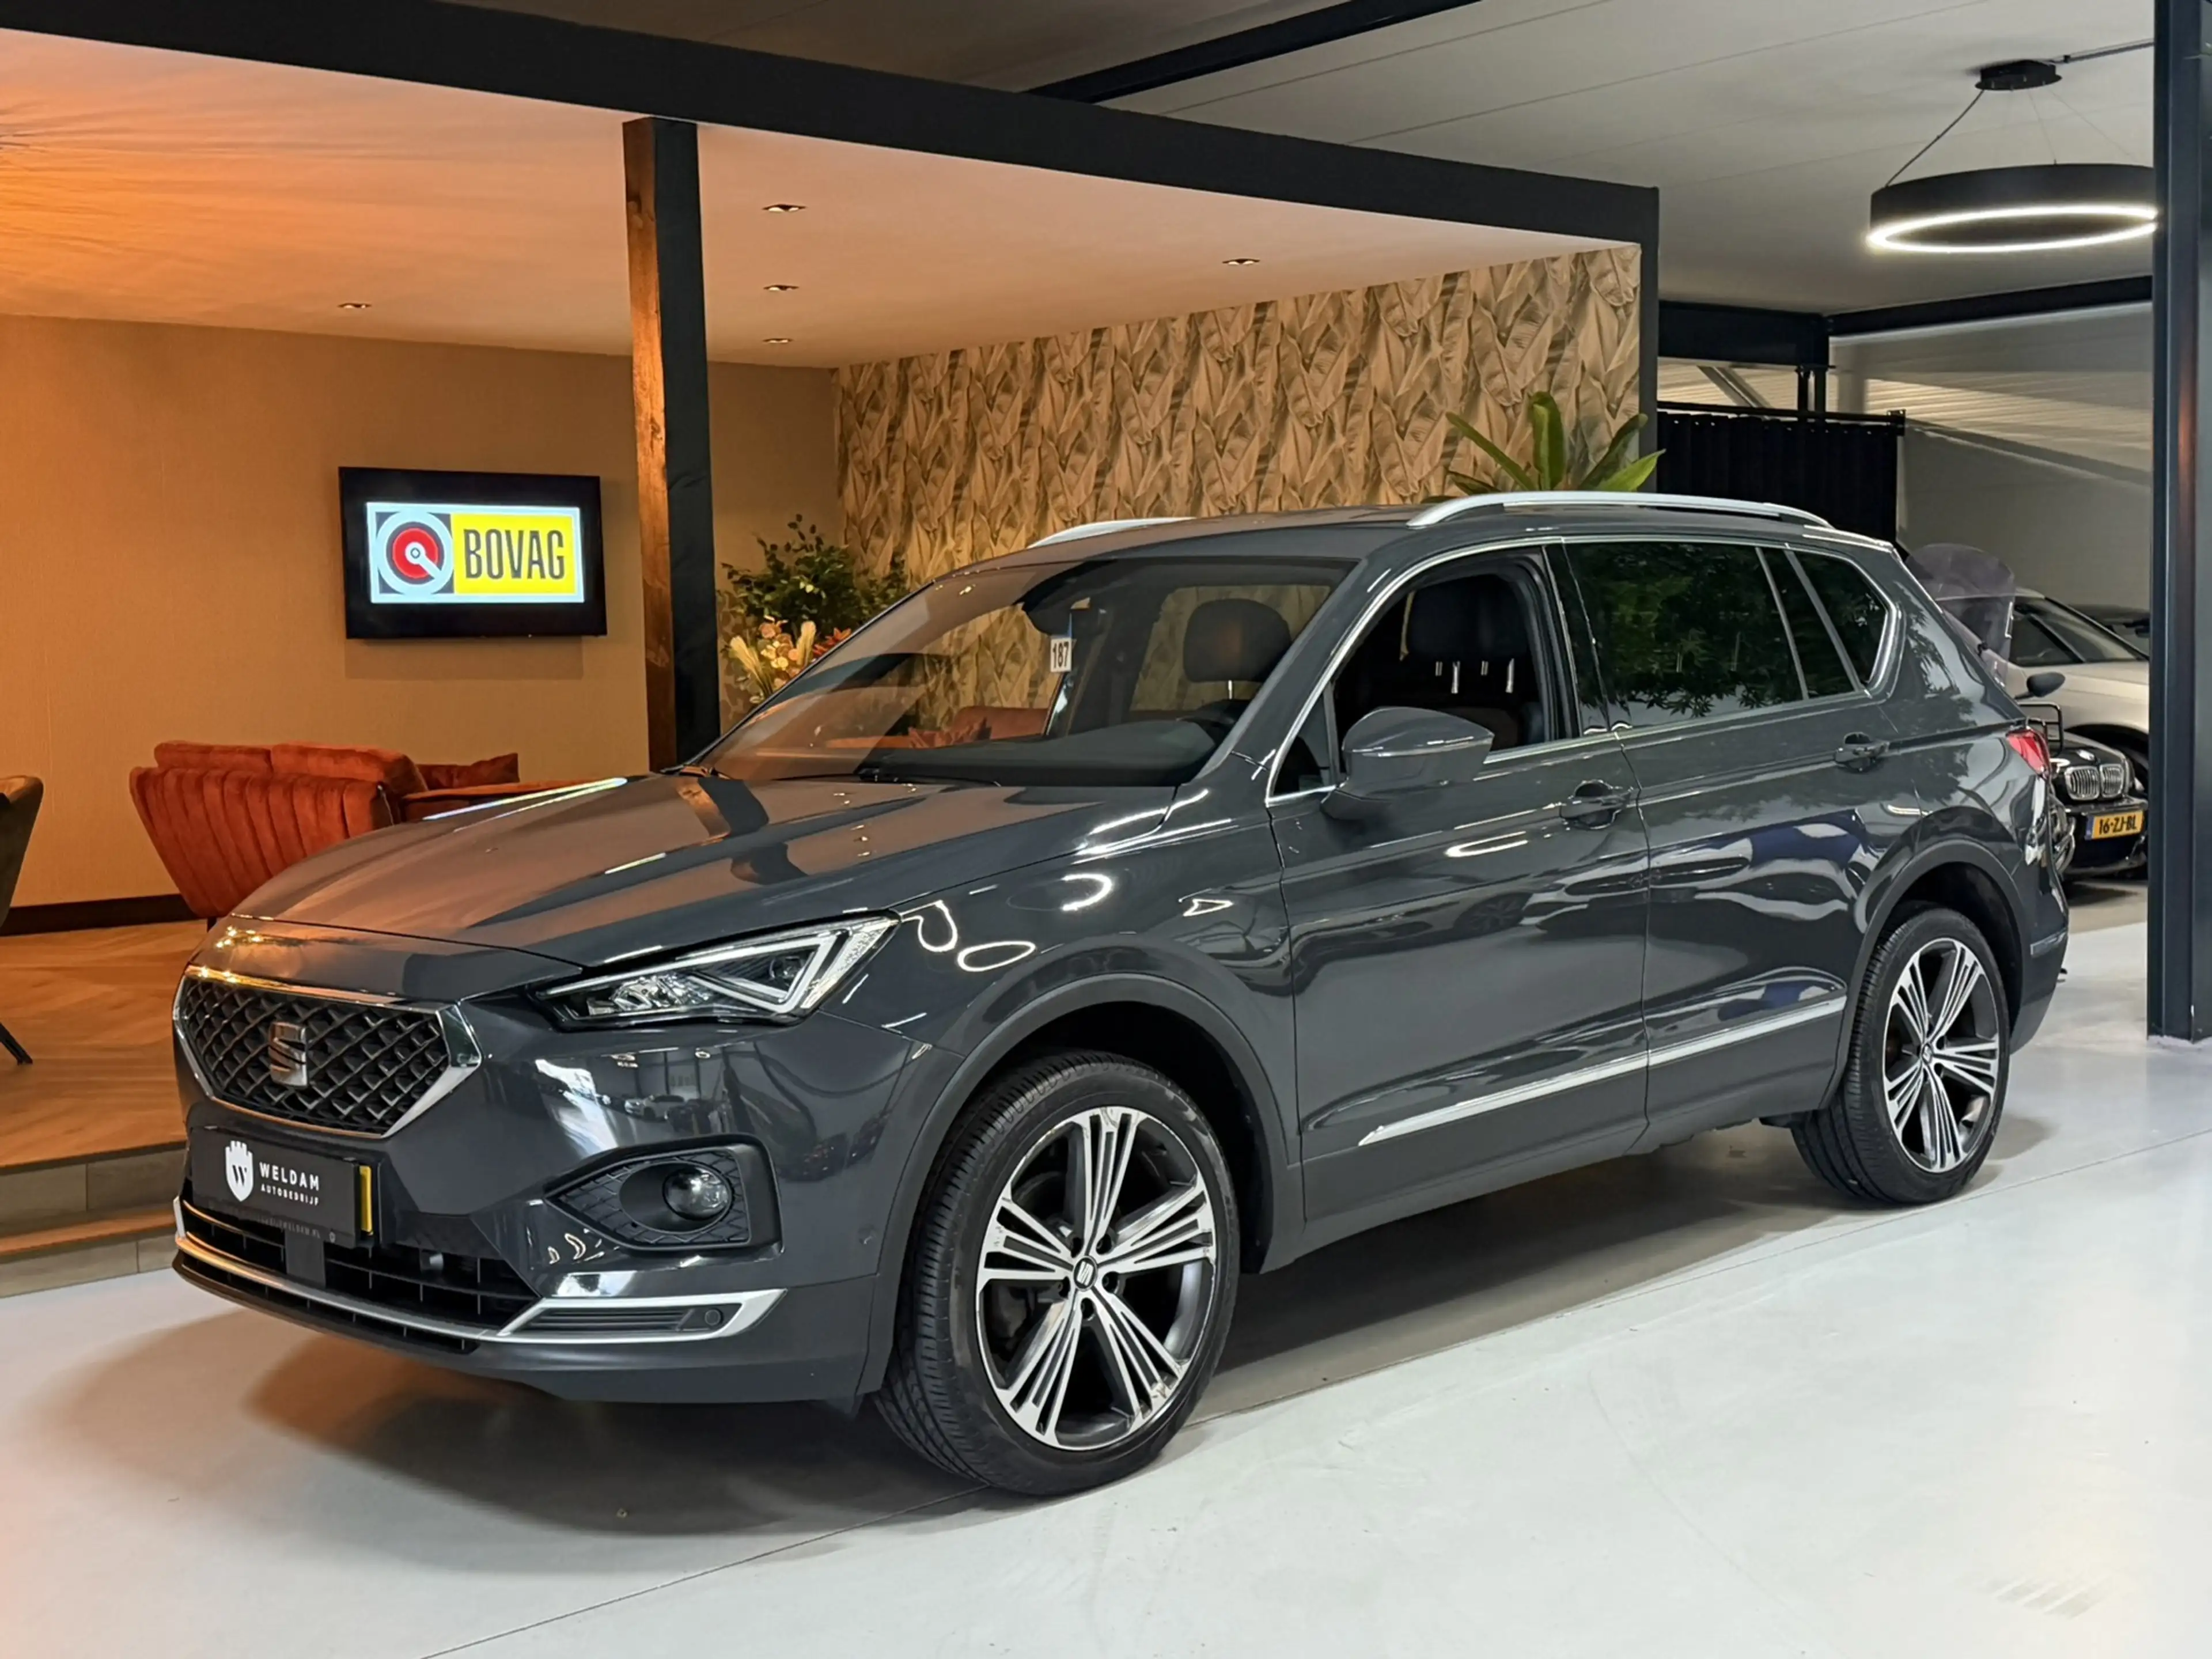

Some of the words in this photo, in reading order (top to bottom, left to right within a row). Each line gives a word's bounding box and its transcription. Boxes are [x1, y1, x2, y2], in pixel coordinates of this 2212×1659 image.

[463, 528, 565, 580] BOVAG
[1052, 641, 1069, 669] 187
[259, 1161, 320, 1191] WELDAM
[260, 1183, 320, 1206] AUTOBEDRIJF
